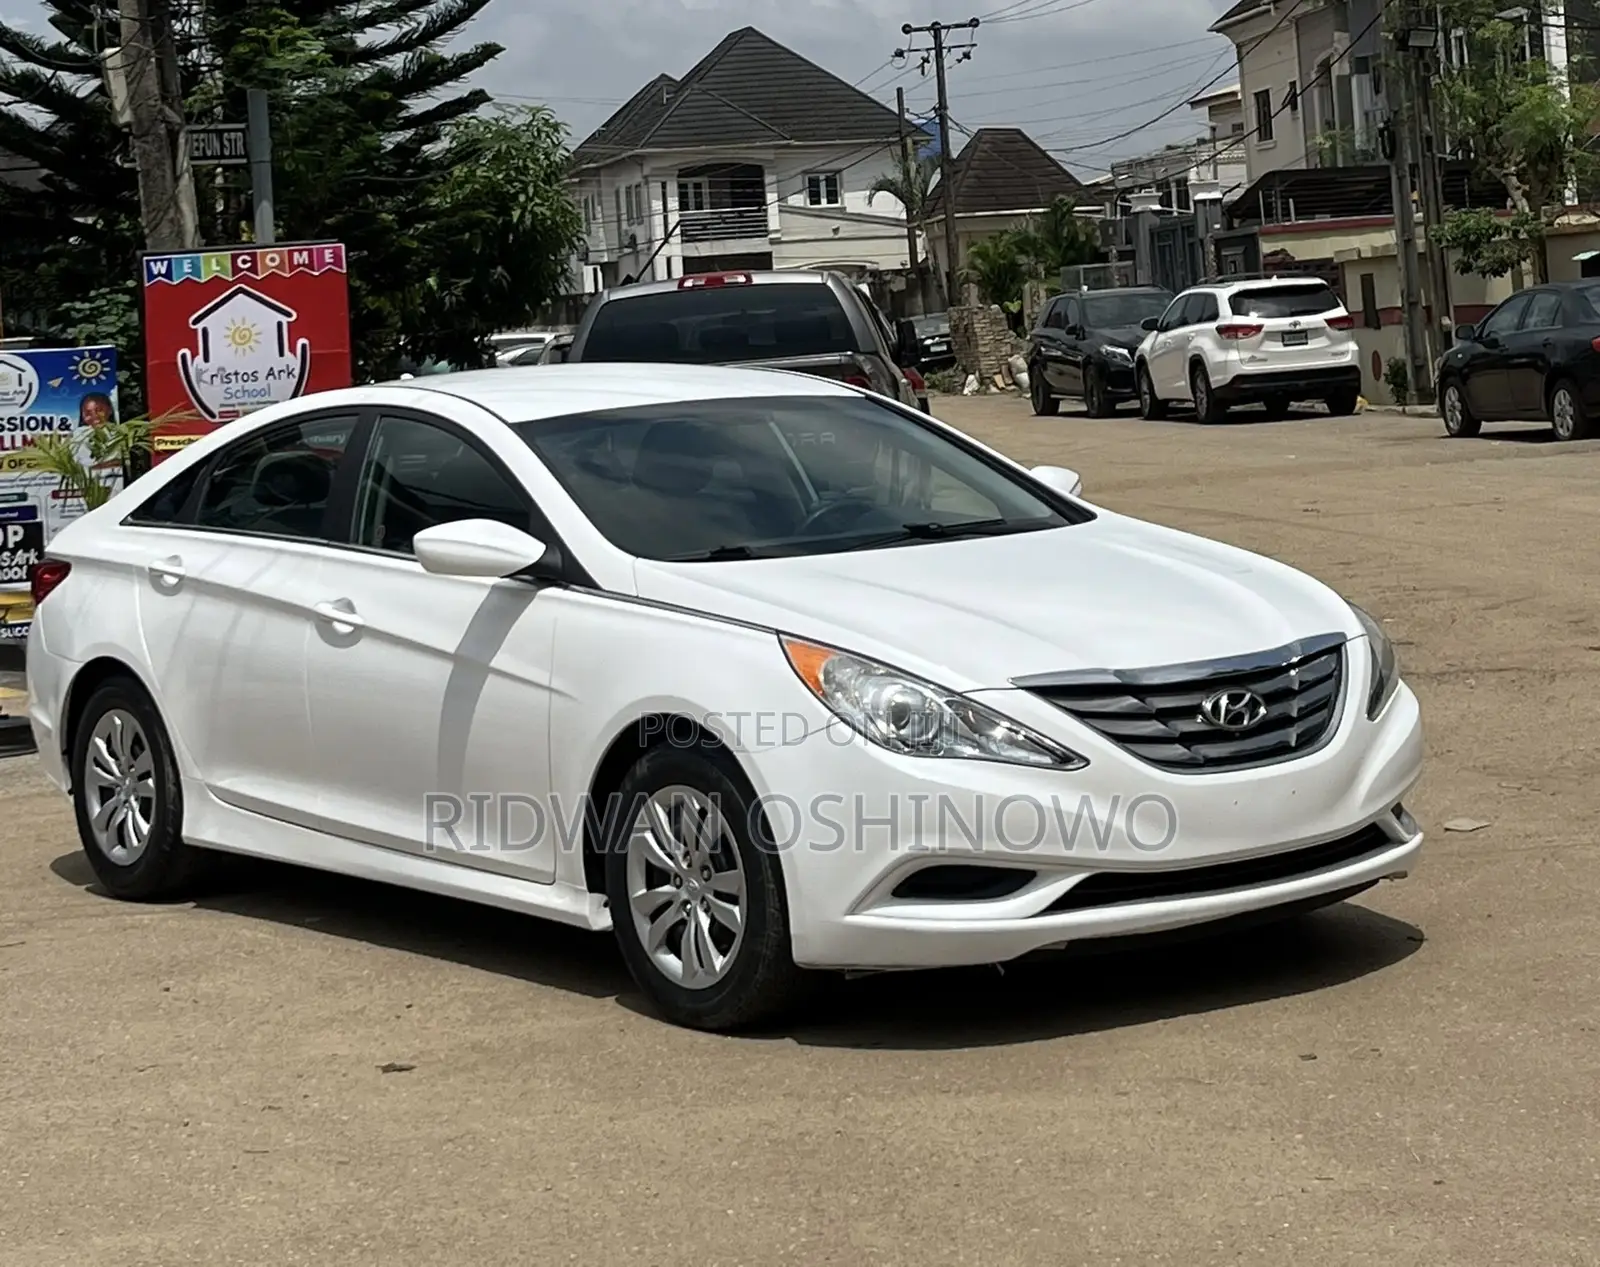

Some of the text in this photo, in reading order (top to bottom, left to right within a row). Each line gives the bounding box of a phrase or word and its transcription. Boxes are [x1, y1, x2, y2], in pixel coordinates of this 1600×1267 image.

[189, 131, 245, 157] EFUN STR
[149, 250, 334, 275] WELCOME
[195, 364, 297, 386] Kristos Ark
[223, 383, 272, 400] School
[57, 417, 72, 431] &
[0, 565, 28, 580] ool
[1, 626, 29, 638] SUCC
